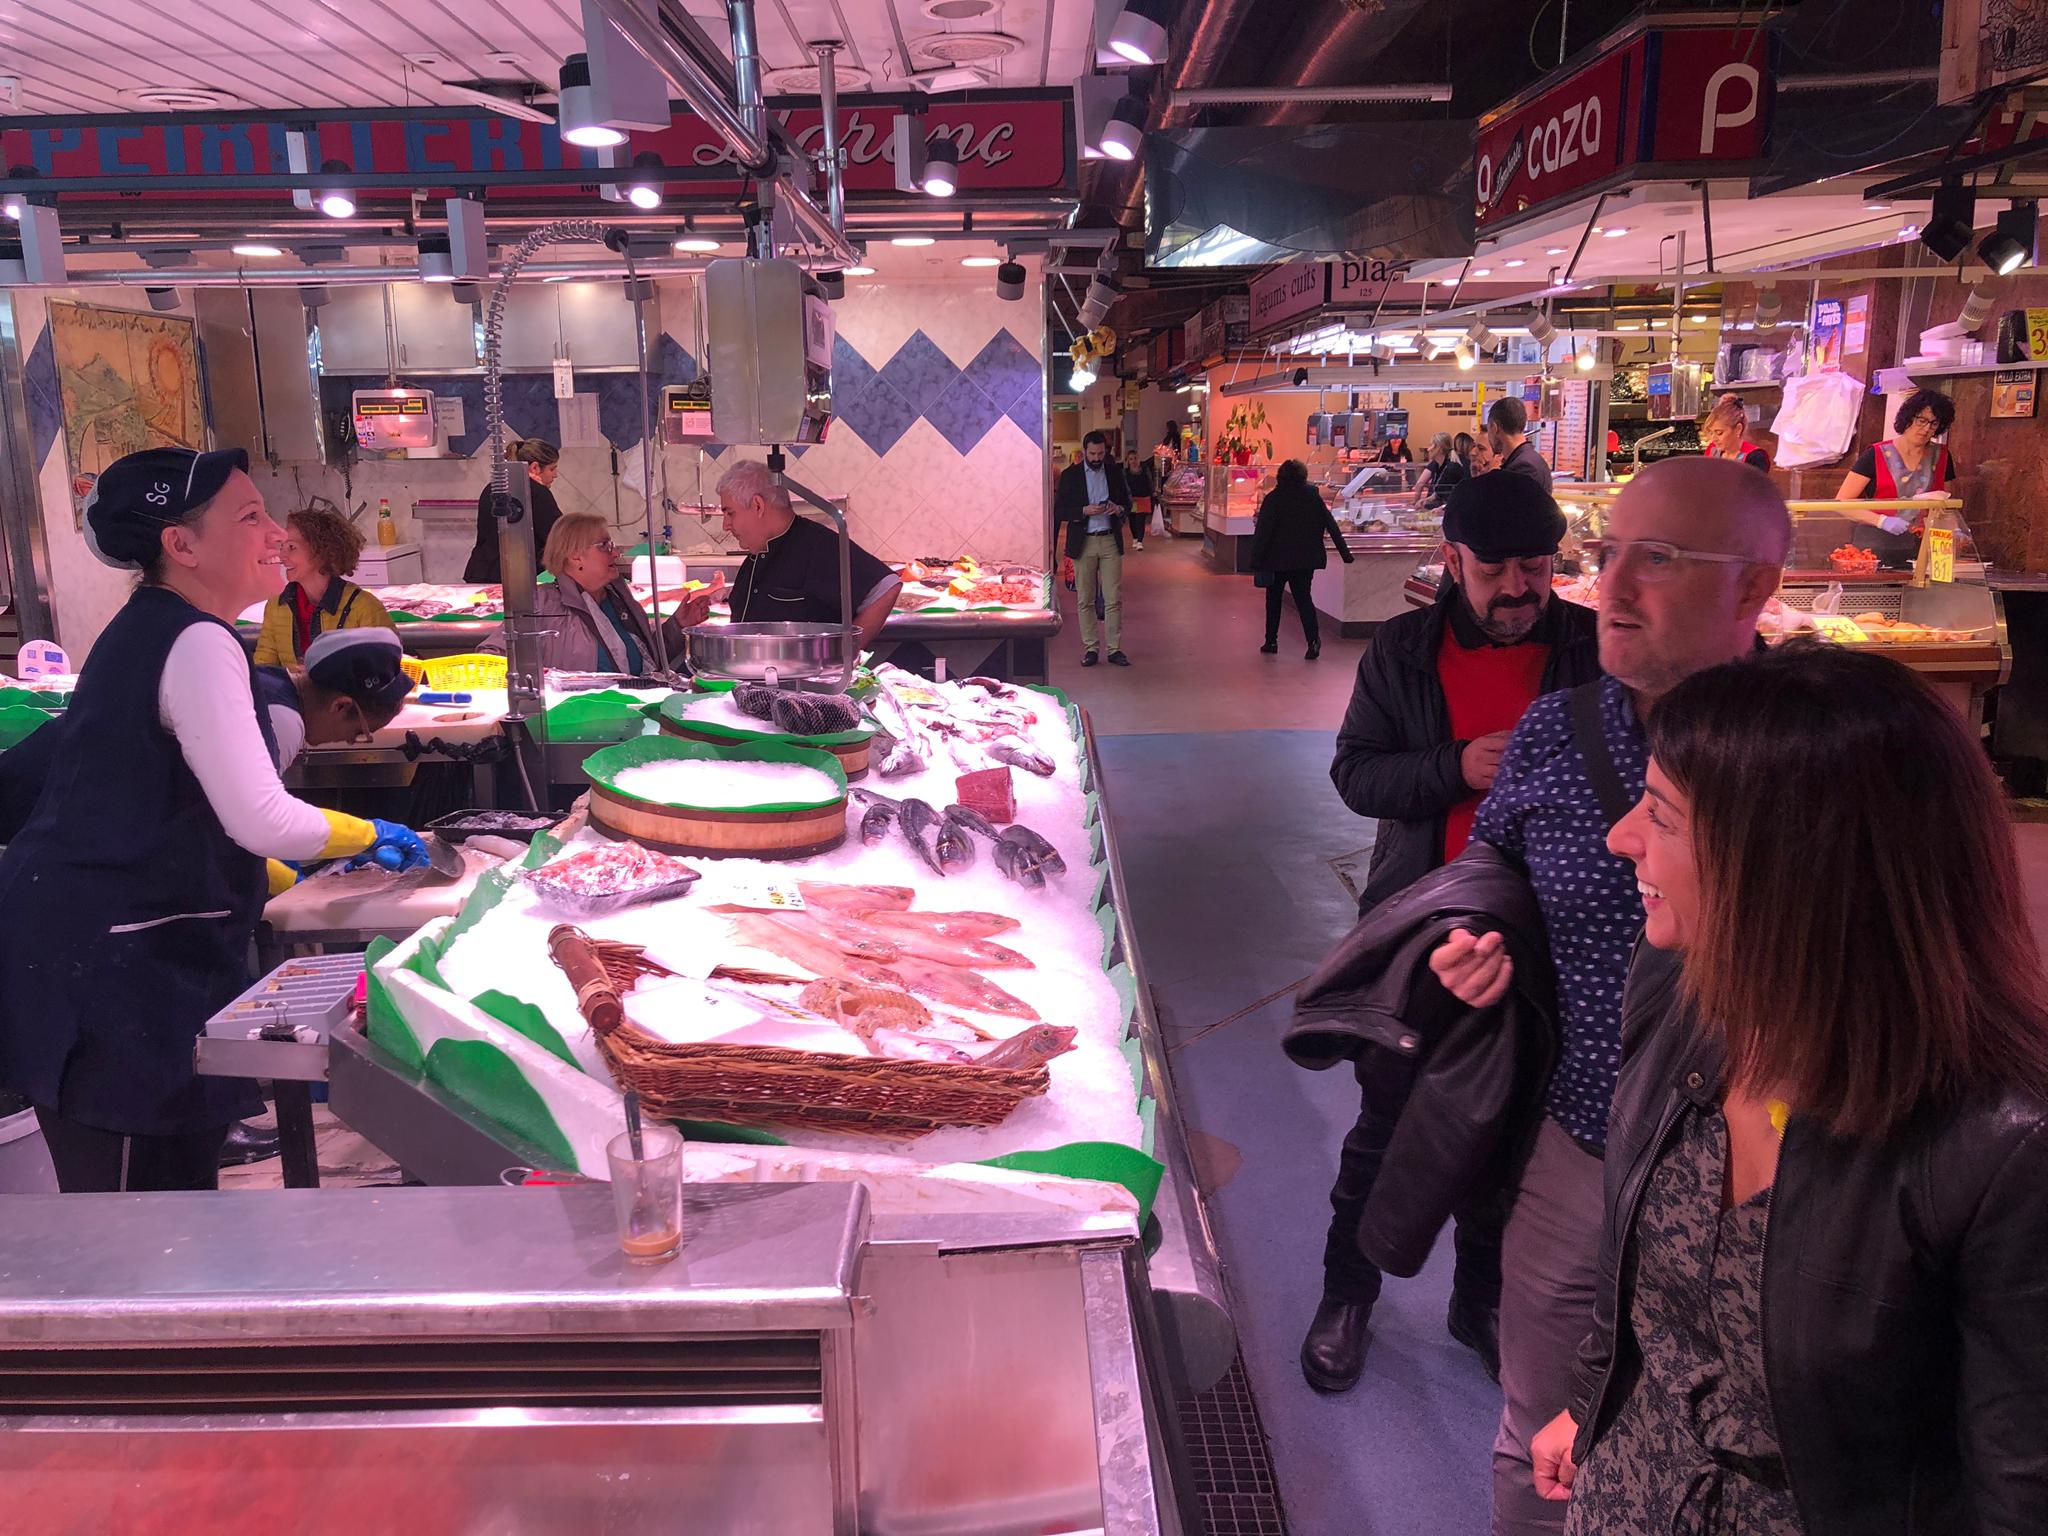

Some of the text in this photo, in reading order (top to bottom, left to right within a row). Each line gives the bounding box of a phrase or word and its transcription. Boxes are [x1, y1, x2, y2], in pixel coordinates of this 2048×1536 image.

[1291, 264, 1316, 297] cuits
[1359, 288, 1373, 297] 125
[146, 482, 170, 505] SG
